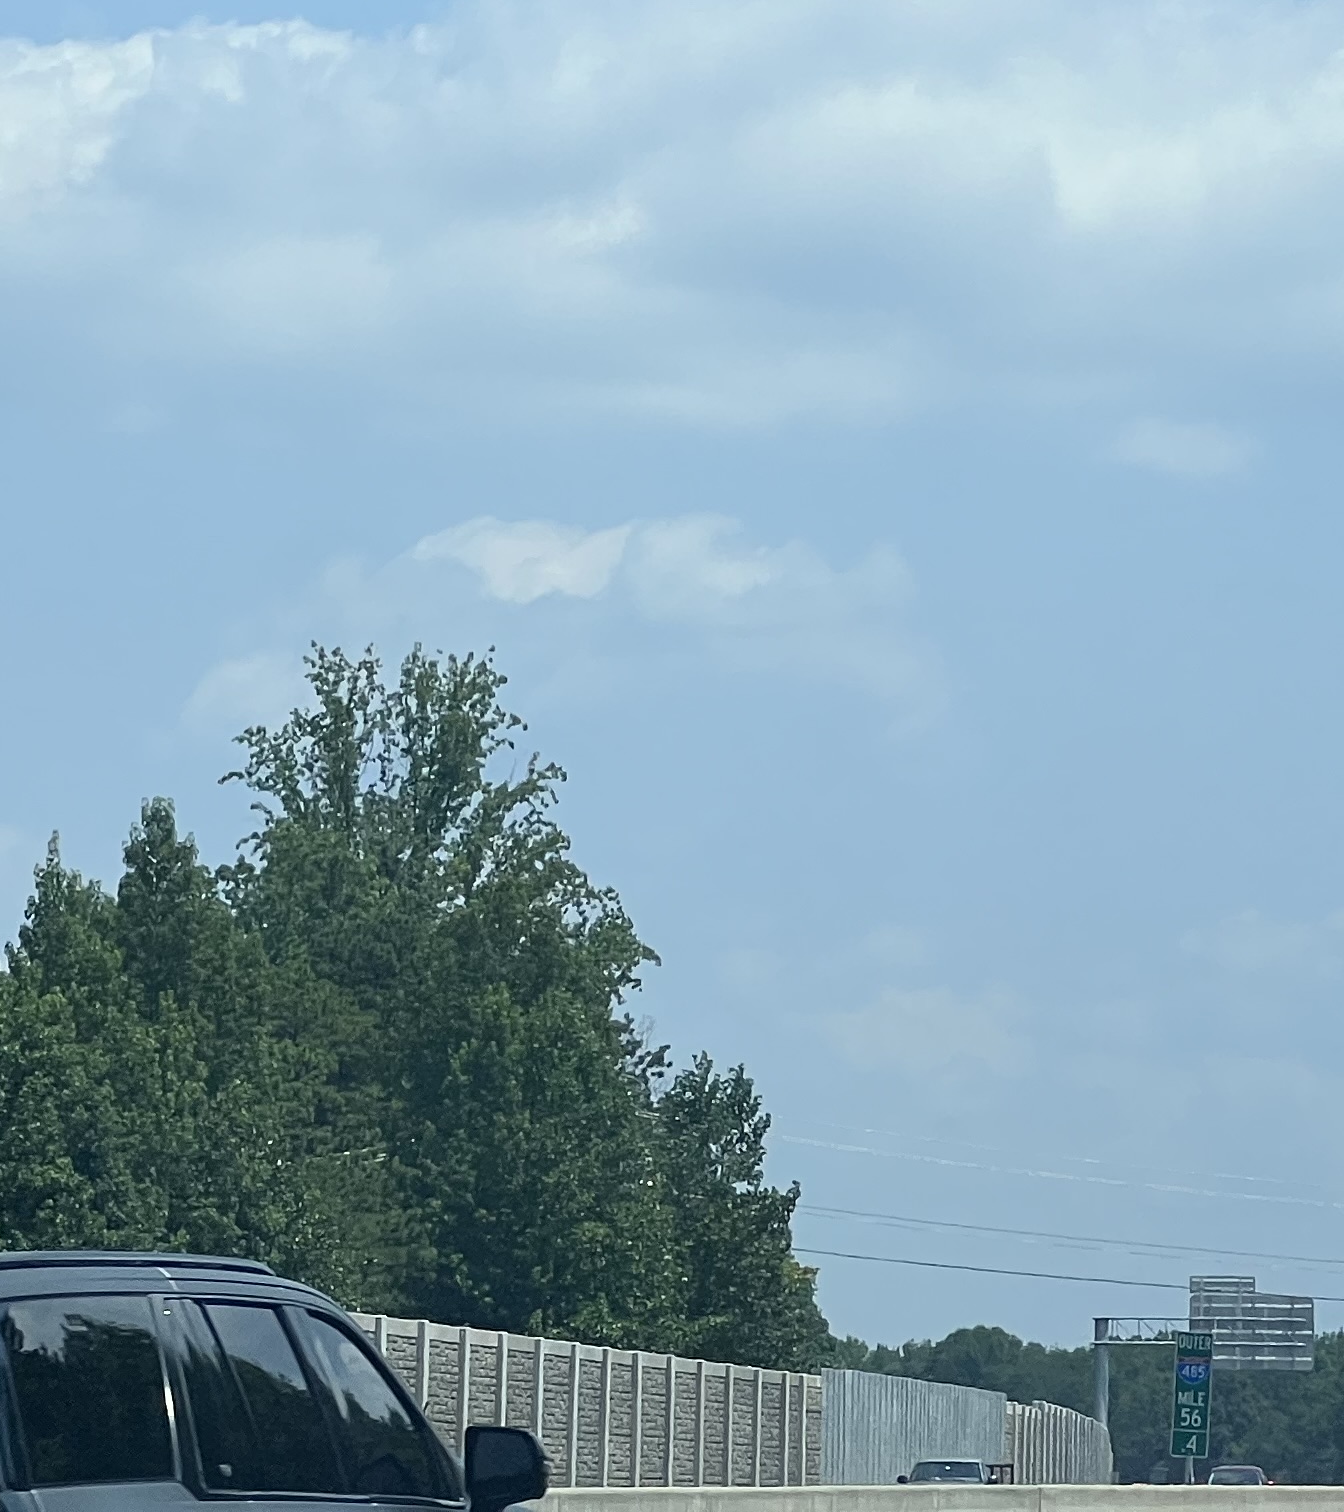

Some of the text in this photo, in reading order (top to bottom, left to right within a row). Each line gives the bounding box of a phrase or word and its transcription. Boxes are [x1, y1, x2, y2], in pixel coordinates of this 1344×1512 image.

[1178, 1333, 1212, 1350] OUTER
[1177, 1390, 1206, 1407] MILE
[1180, 1407, 1202, 1428] 56
